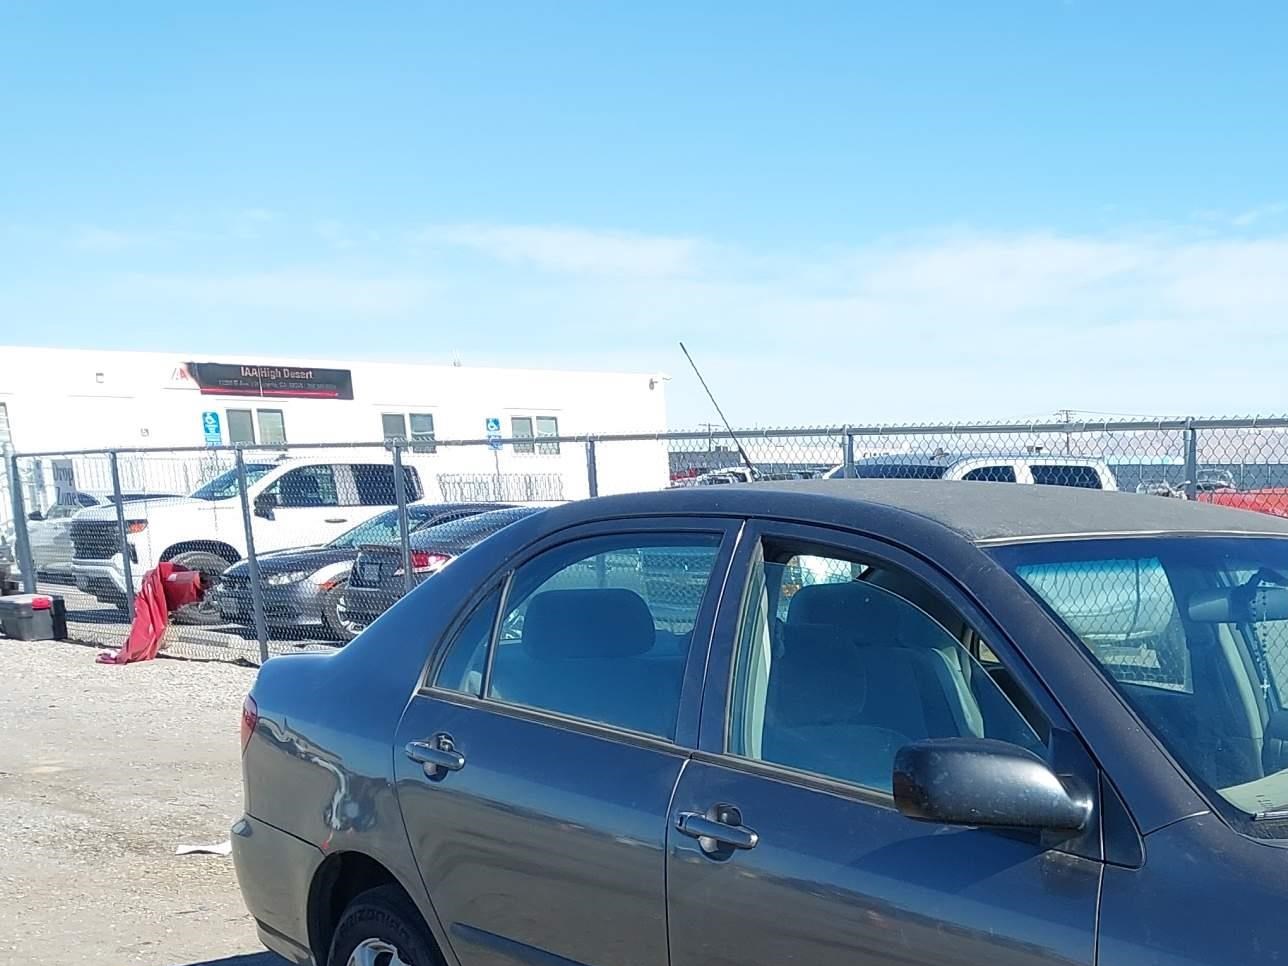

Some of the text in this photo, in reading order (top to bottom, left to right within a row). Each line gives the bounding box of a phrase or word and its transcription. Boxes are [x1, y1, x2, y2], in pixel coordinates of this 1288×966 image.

[241, 366, 313, 380] IAA High Desert
[53, 463, 74, 487] Drop
